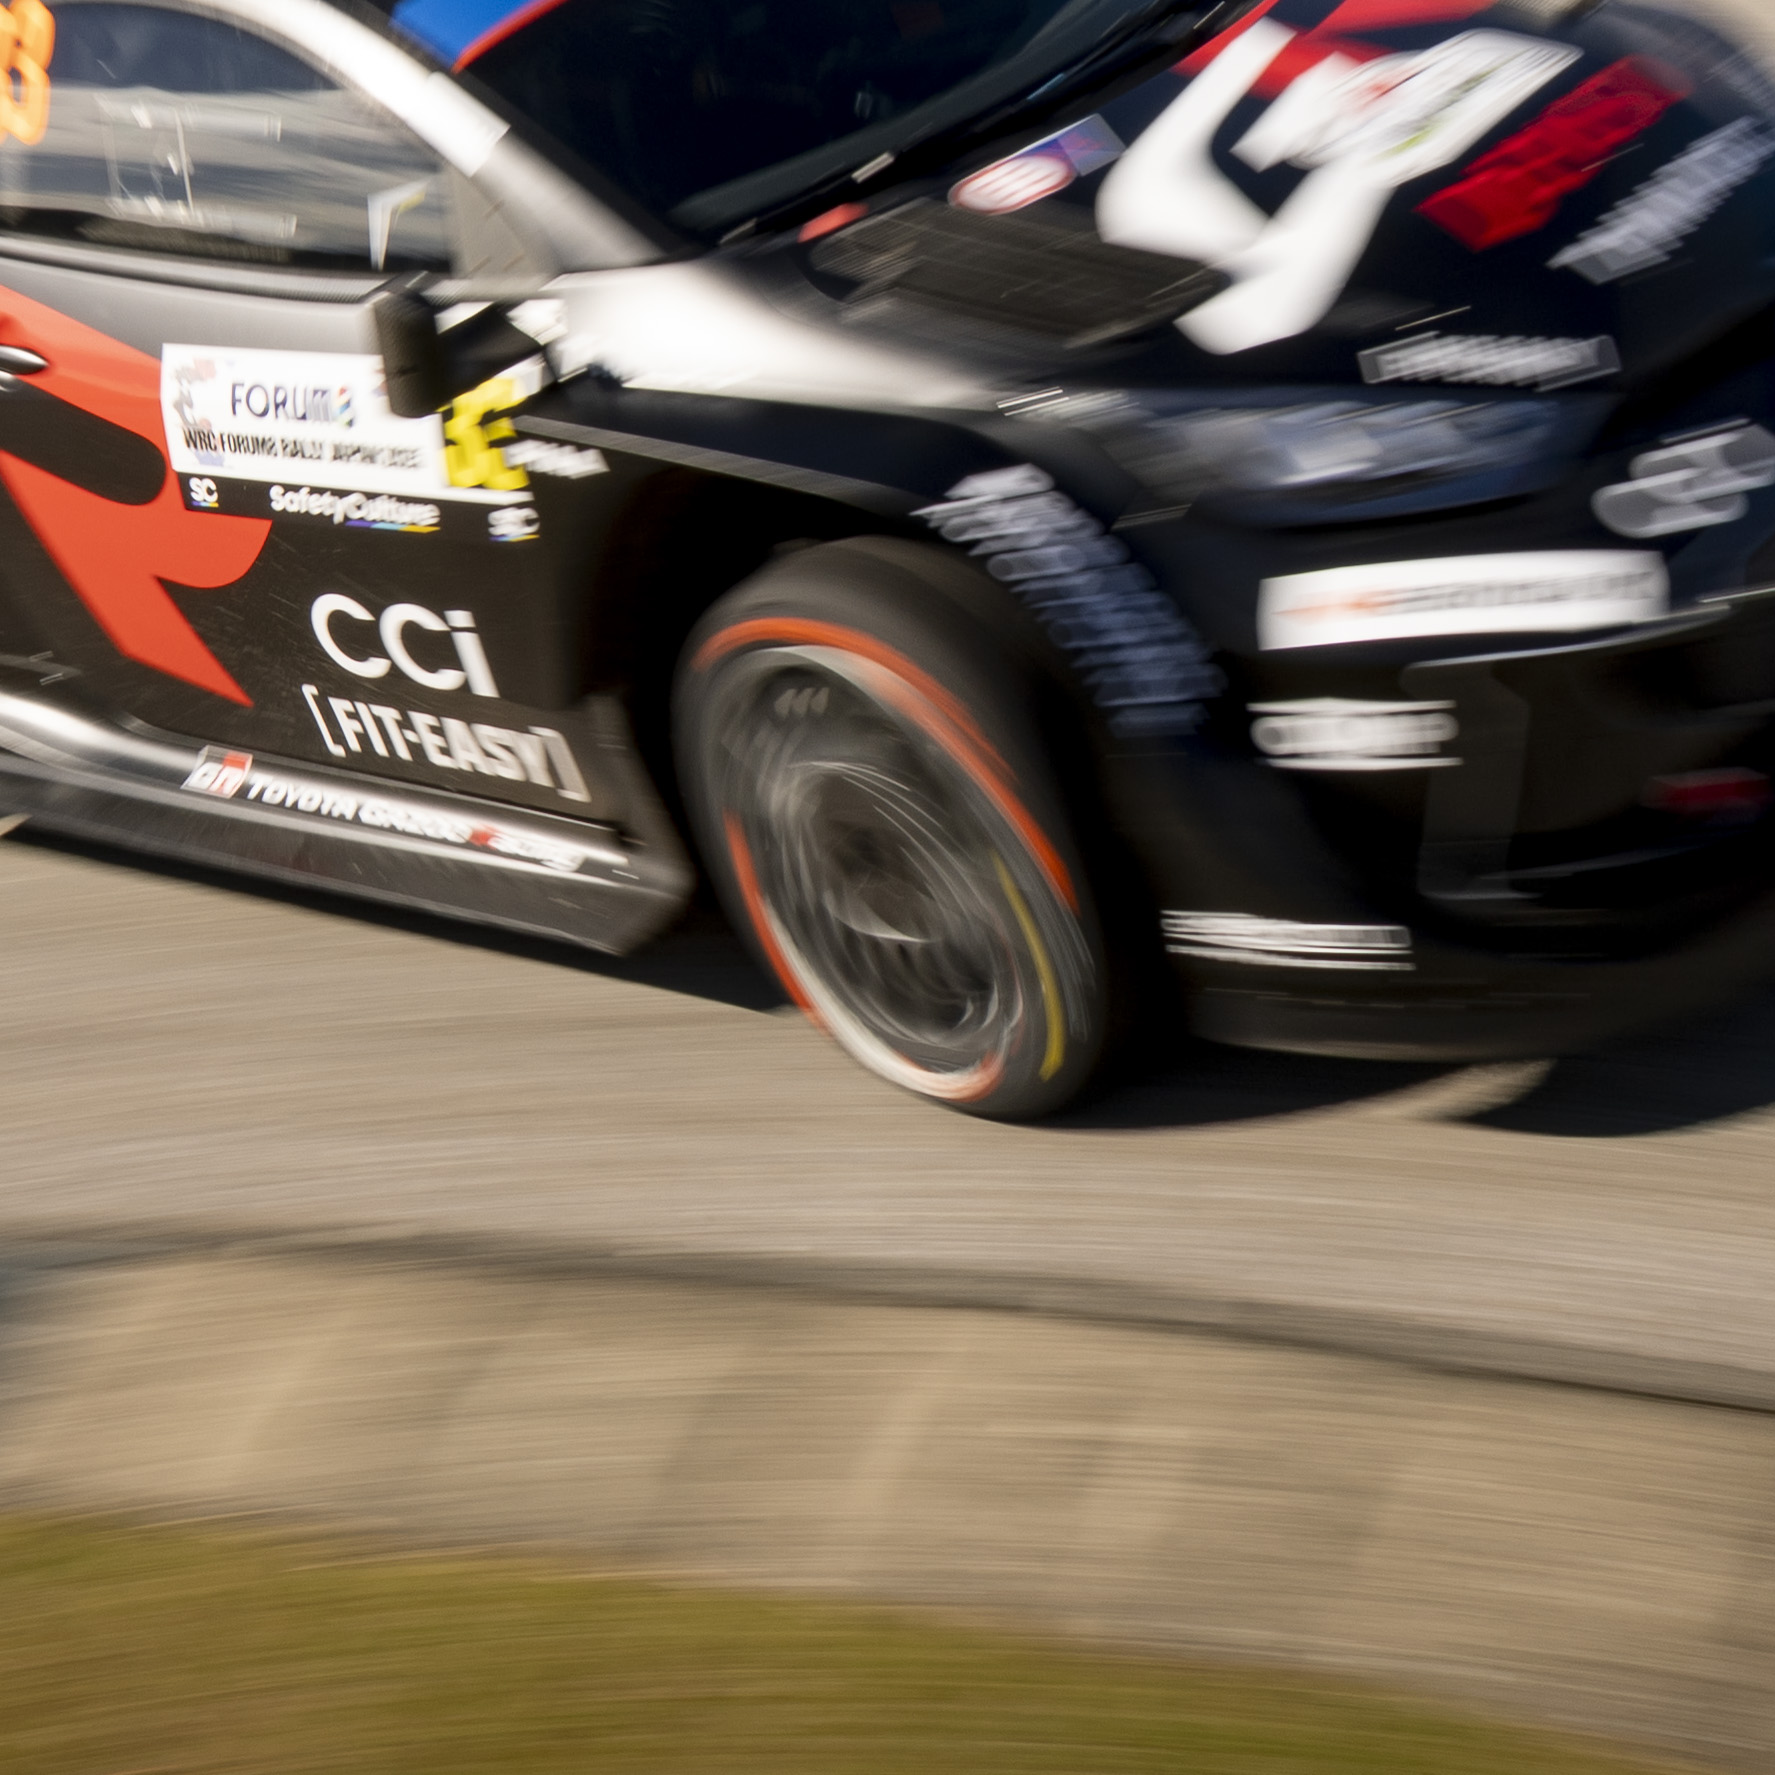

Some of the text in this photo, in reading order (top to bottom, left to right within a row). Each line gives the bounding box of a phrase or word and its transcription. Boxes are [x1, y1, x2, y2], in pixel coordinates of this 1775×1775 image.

[181, 426, 218, 453] WRC
[269, 484, 441, 525] SafetyCulture
[310, 592, 501, 699] CCi
[246, 771, 362, 821] TOYOTA
